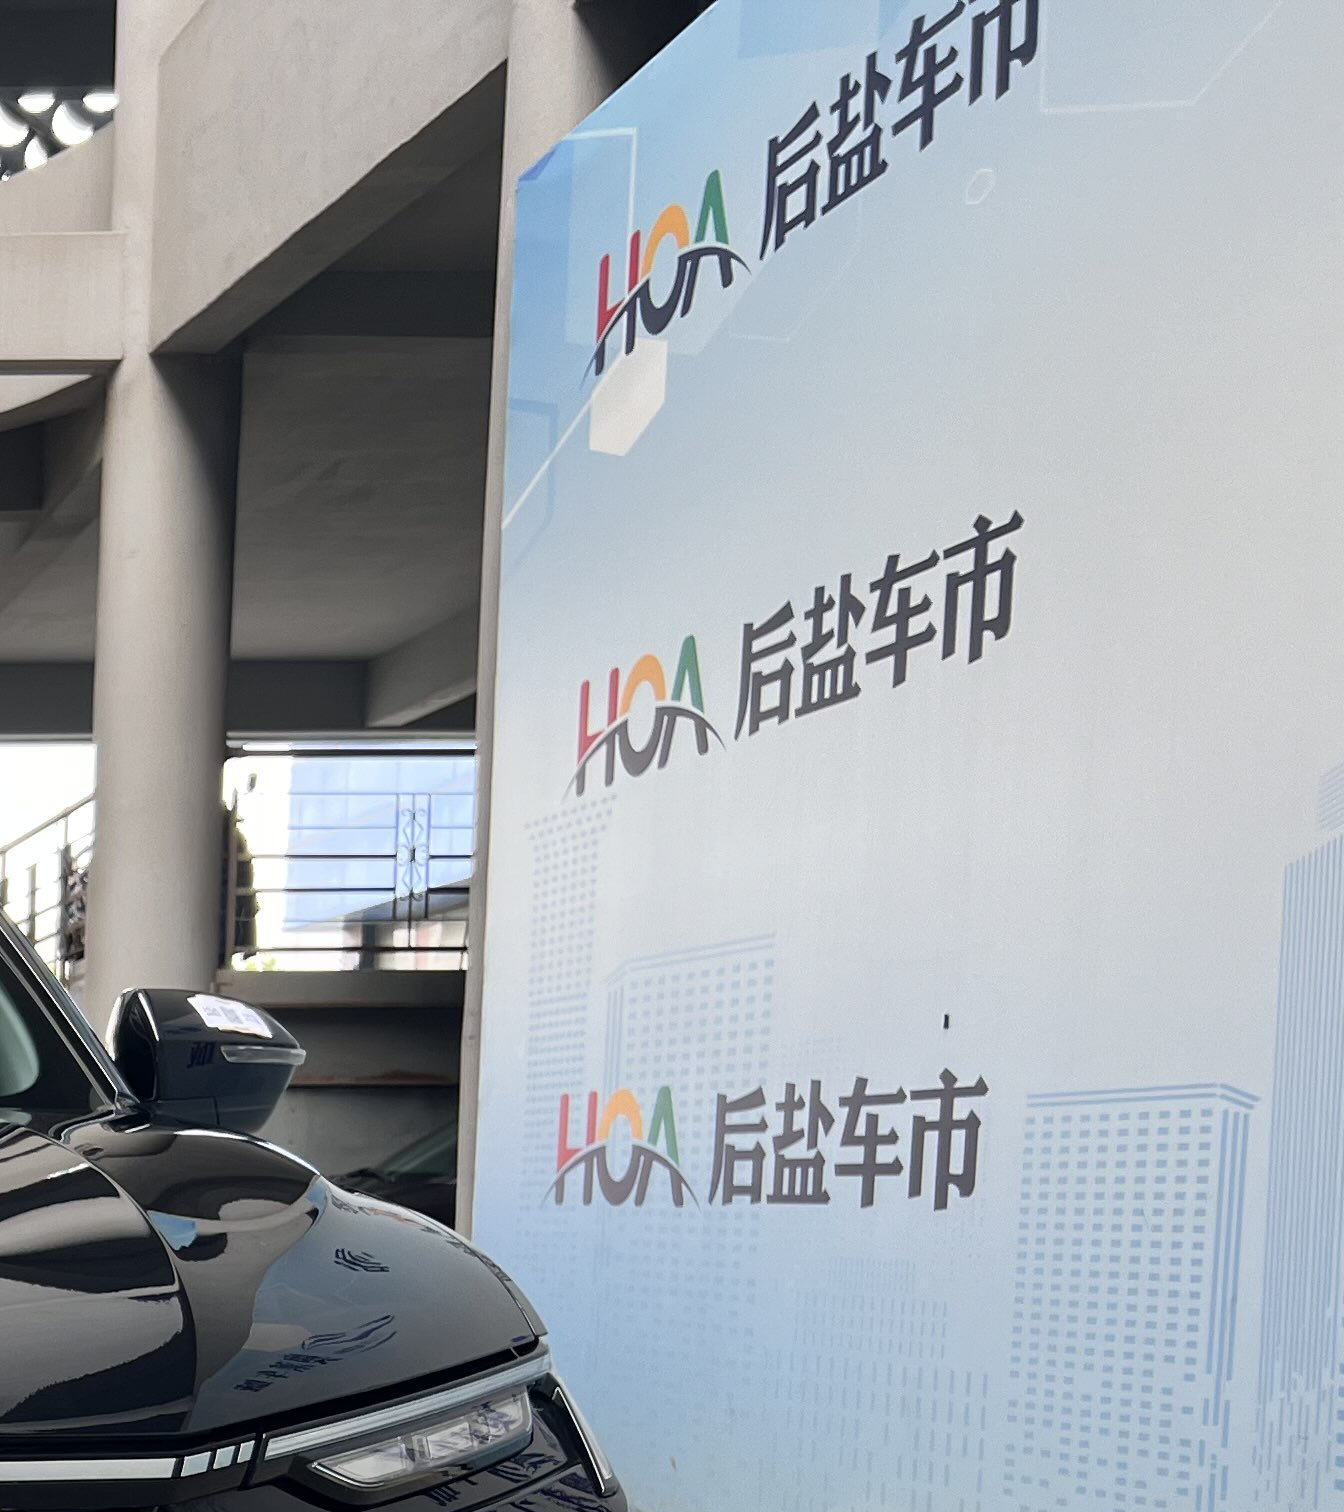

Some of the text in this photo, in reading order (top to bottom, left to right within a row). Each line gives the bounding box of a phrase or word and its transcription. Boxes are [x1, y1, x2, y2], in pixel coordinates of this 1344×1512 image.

[588, 168, 740, 378] HOA
[733, 510, 1024, 741] 后盐车市
[570, 635, 716, 797] HOA
[548, 1085, 691, 1208] HOA
[708, 1067, 989, 1212] 后盐车市
